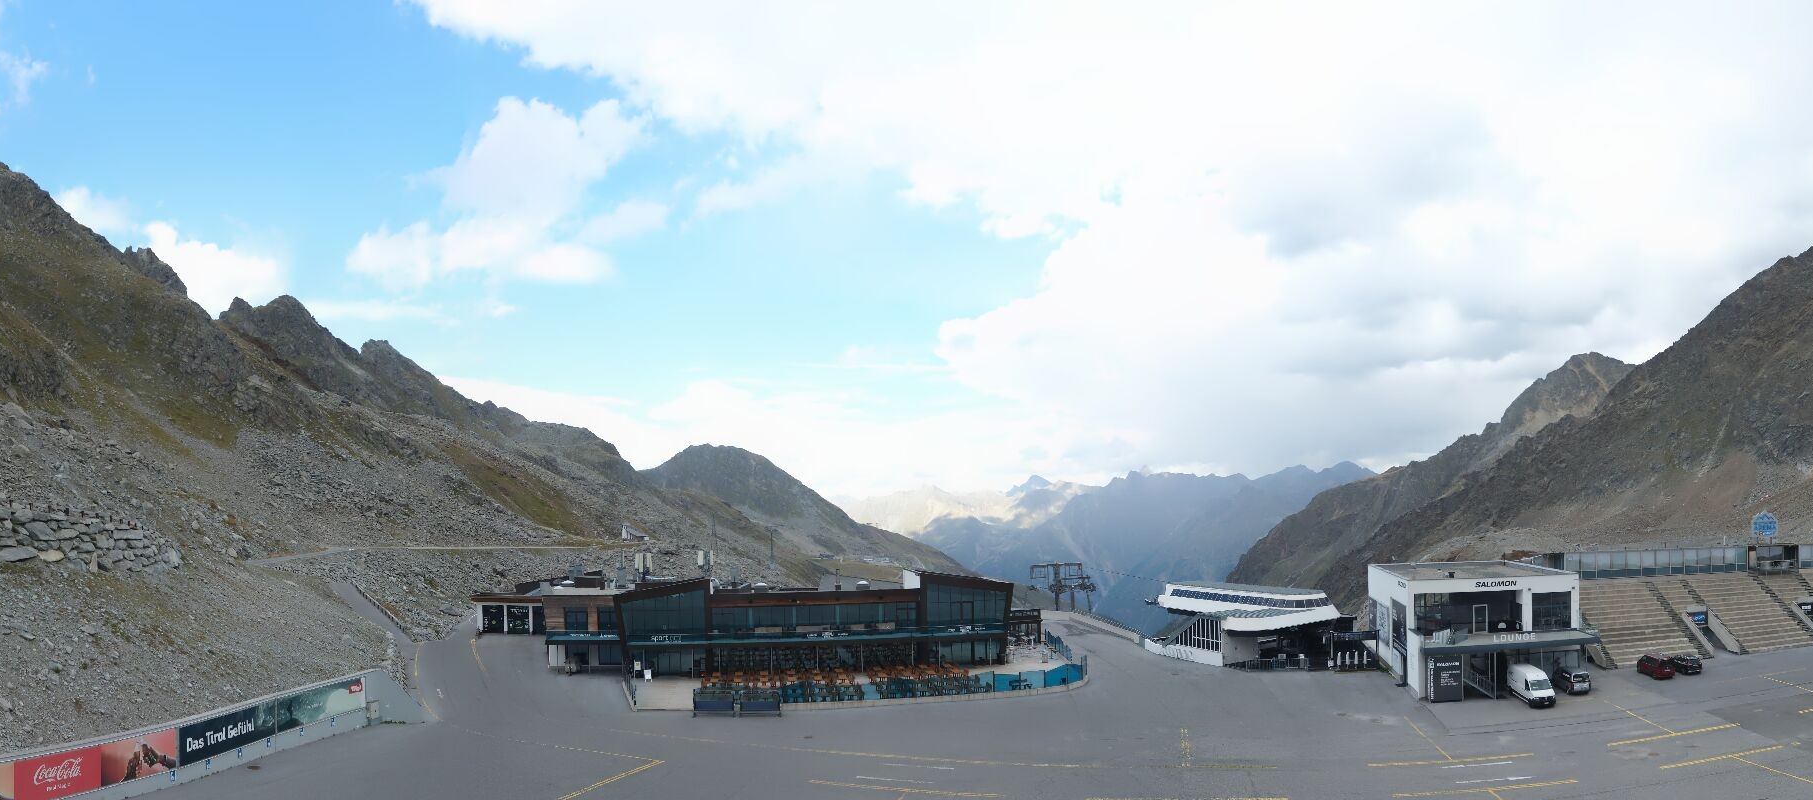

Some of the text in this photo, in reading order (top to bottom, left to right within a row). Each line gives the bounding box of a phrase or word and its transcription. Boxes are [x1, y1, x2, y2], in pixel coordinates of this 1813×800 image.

[1475, 580, 1517, 588] SALOMON
[650, 634, 669, 643] sport
[1493, 632, 1536, 643] LOUNGE
[186, 717, 255, 753] Das Tirol Gefühl
